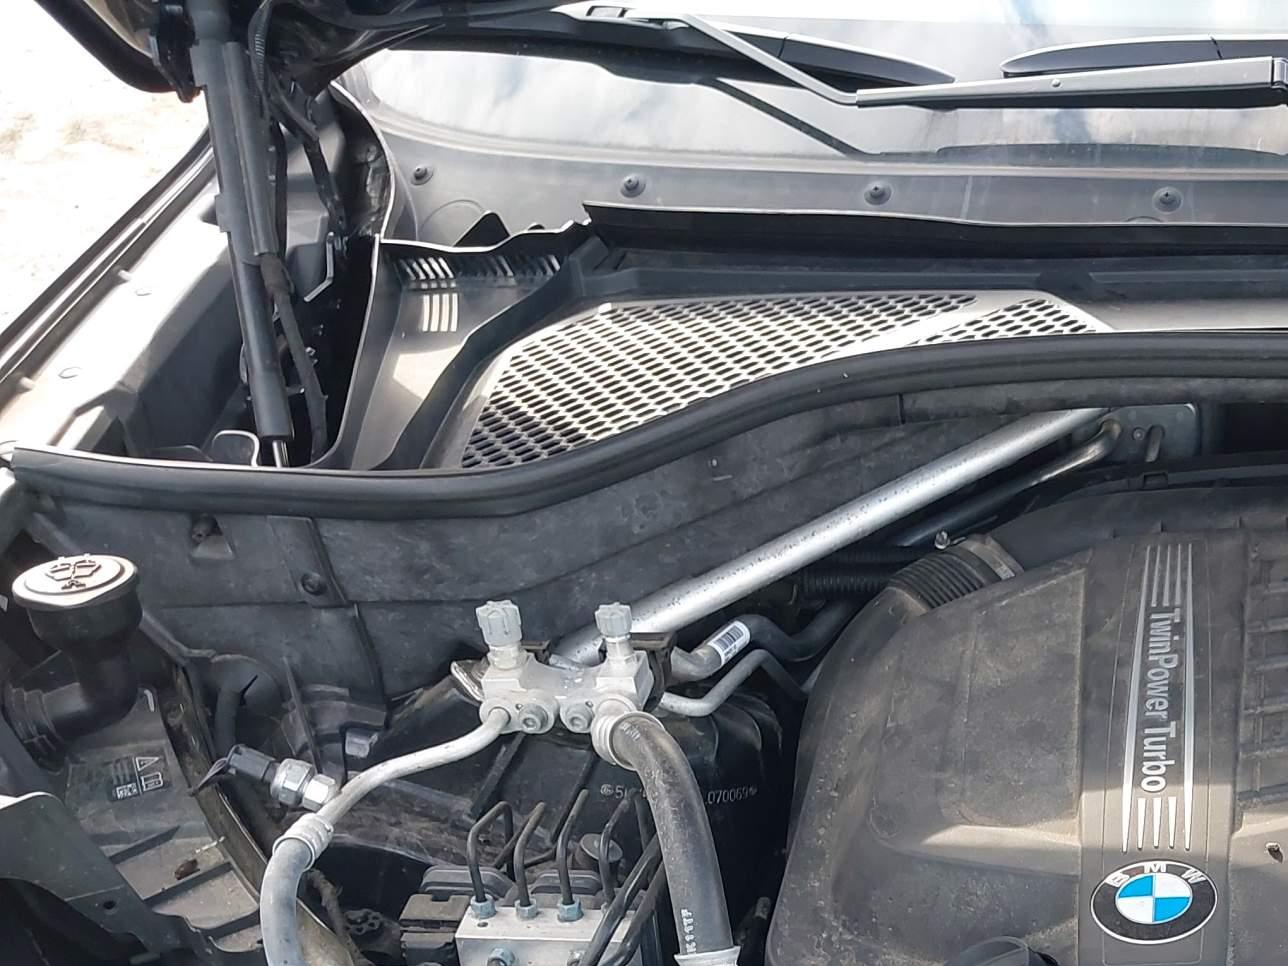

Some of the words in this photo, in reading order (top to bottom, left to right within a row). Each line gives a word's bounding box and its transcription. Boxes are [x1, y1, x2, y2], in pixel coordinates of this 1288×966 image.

[1144, 607, 1181, 719] TwinPower
[1140, 721, 1177, 793] Turbo
[1104, 863, 1207, 888] BMW
